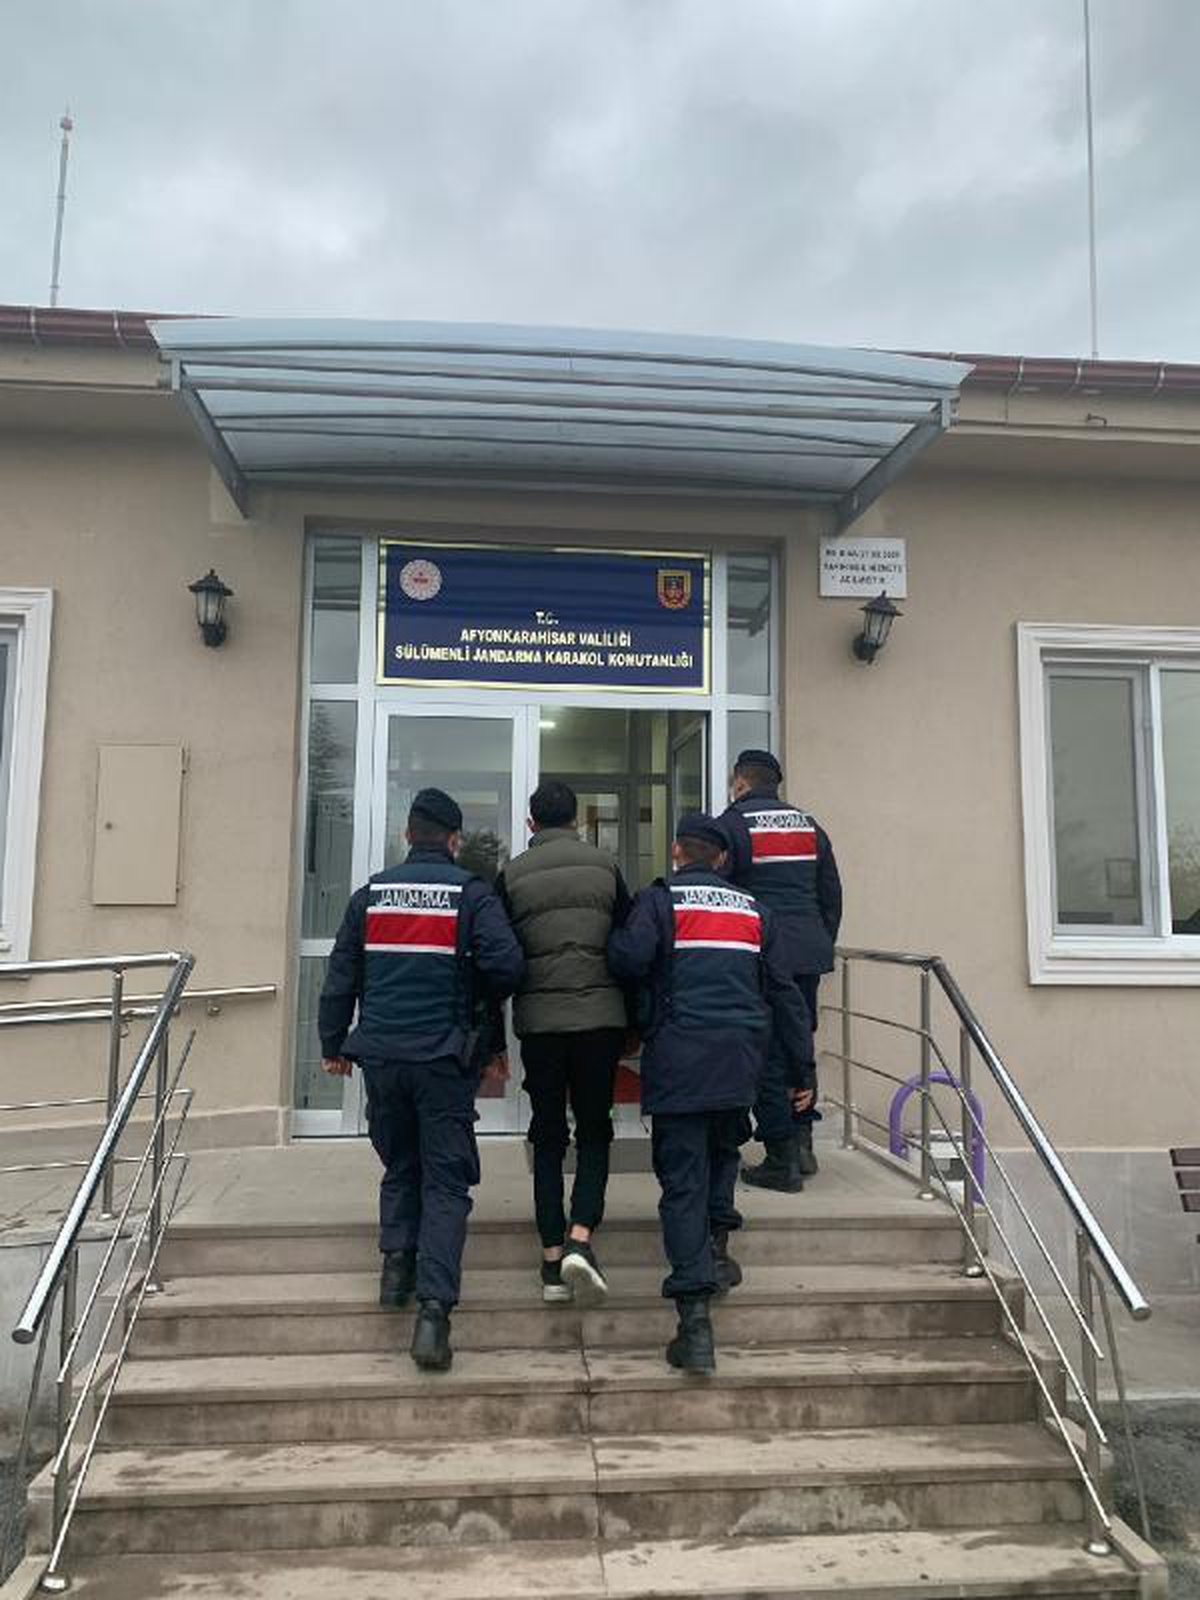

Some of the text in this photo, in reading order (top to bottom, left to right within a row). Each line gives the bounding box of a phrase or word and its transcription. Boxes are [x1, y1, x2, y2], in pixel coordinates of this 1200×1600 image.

[535, 611, 559, 625] T.C.
[460, 628, 576, 645] AFYONKARAHİSAR
[395, 643, 470, 661] SÜLÜMENLİ
[472, 648, 542, 663] JANDARMA
[545, 650, 605, 666] KARAKOL
[375, 889, 451, 908] JANDARMA
